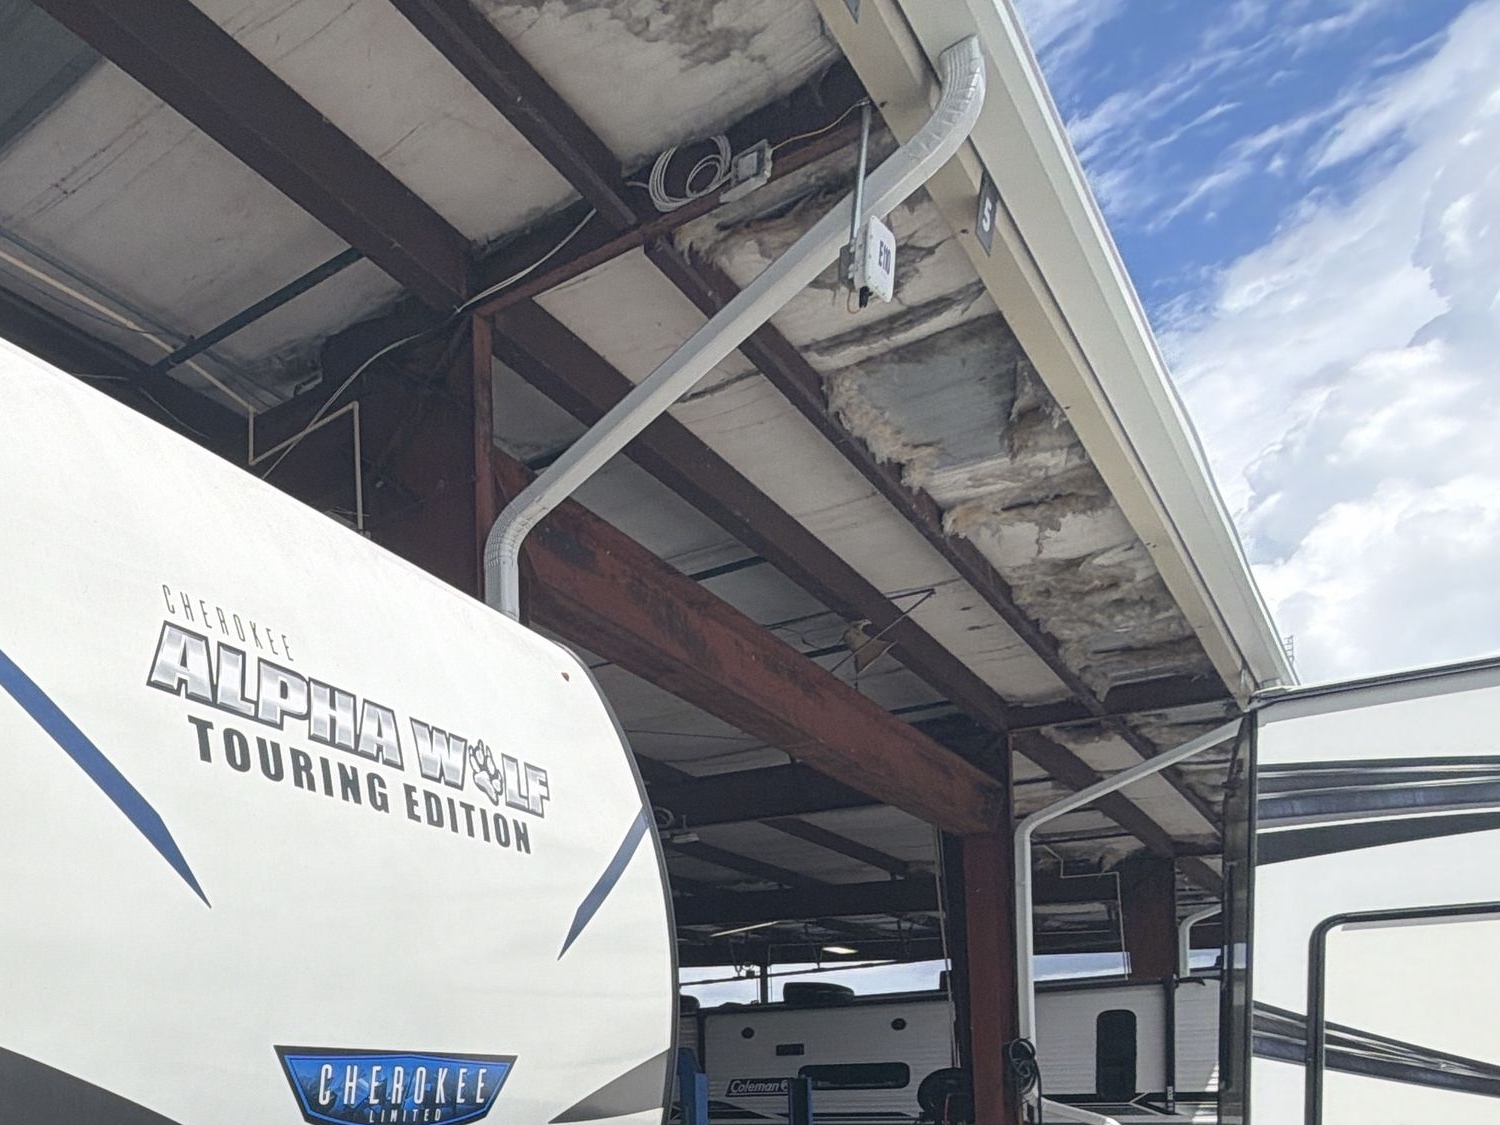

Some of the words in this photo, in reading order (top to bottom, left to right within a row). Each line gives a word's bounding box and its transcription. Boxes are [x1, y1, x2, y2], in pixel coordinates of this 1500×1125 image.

[981, 197, 993, 232] 5
[161, 584, 295, 661] CHEROKEE
[146, 620, 404, 771] ALPHA
[187, 714, 391, 814] TOURING
[404, 784, 532, 855] EDITION
[317, 1064, 488, 1106] CHEROKEE
[730, 1080, 780, 1093] Coleman
[369, 1108, 442, 1124] LIMITED
